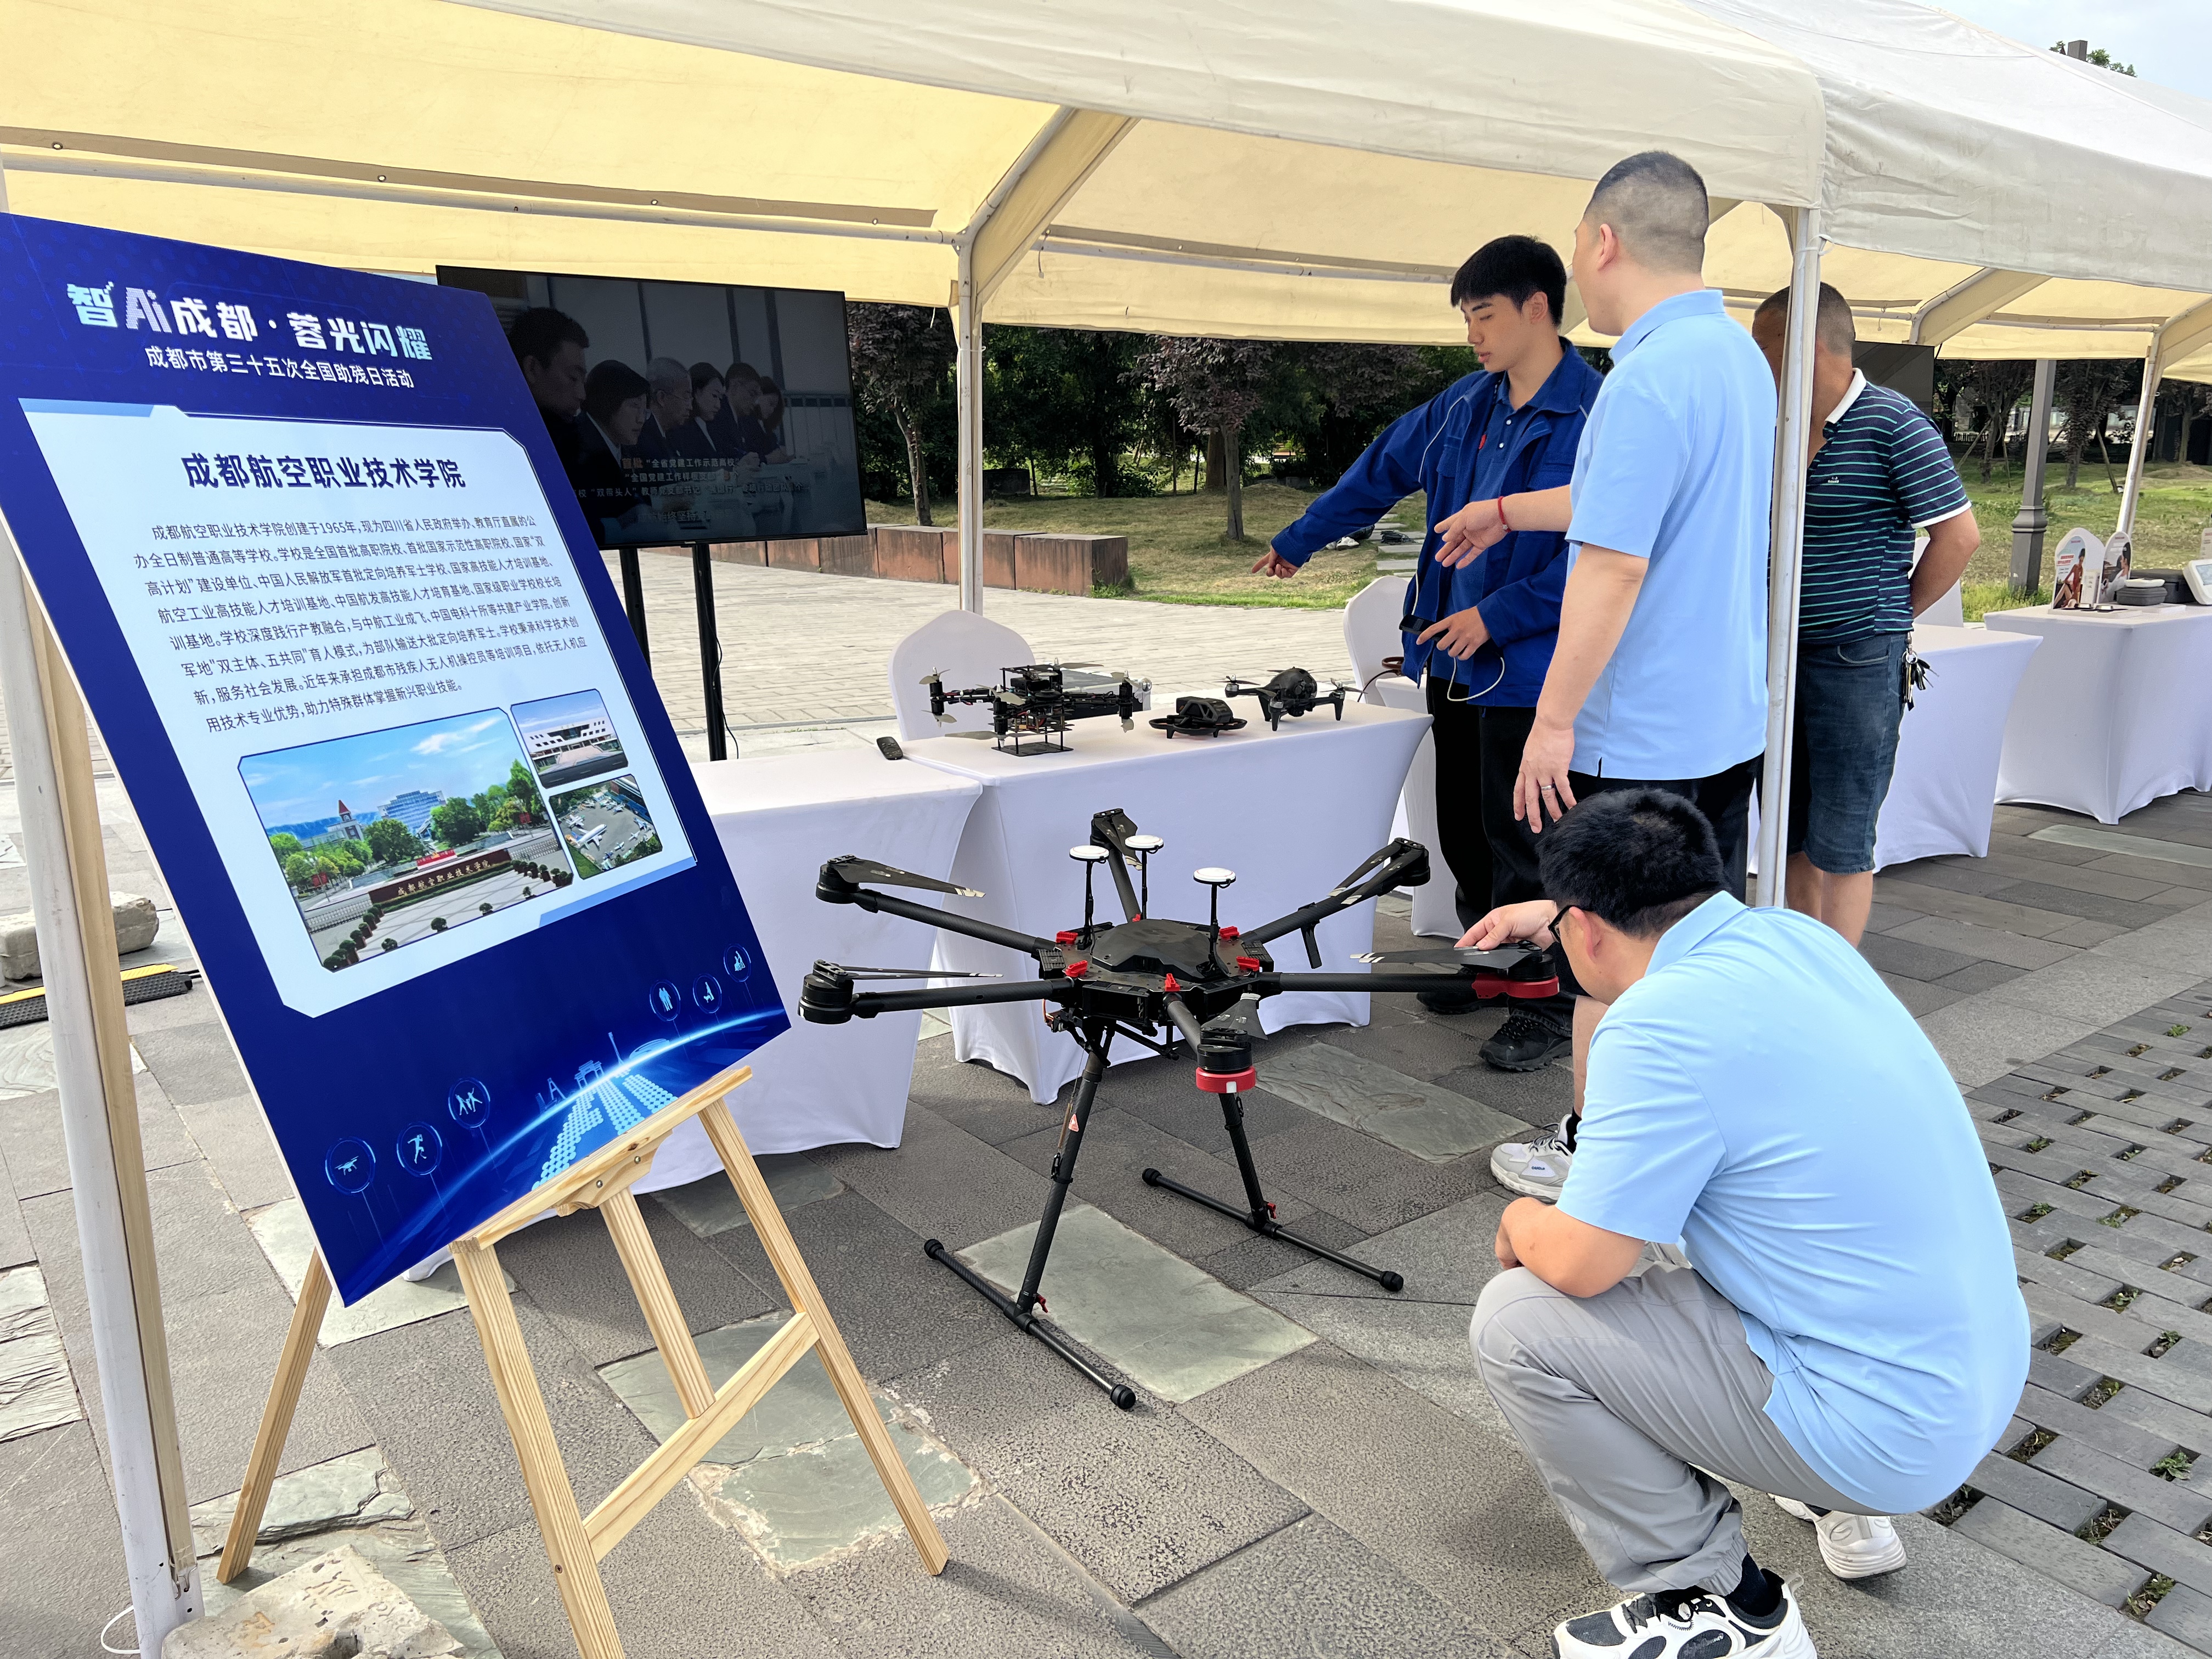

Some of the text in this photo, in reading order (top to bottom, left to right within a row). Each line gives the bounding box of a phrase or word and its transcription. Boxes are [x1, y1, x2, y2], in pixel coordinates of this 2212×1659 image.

[145, 346, 414, 388] 成都市第三十五次全国助残日活动
[181, 453, 466, 488] 成都航空职业技术学院
